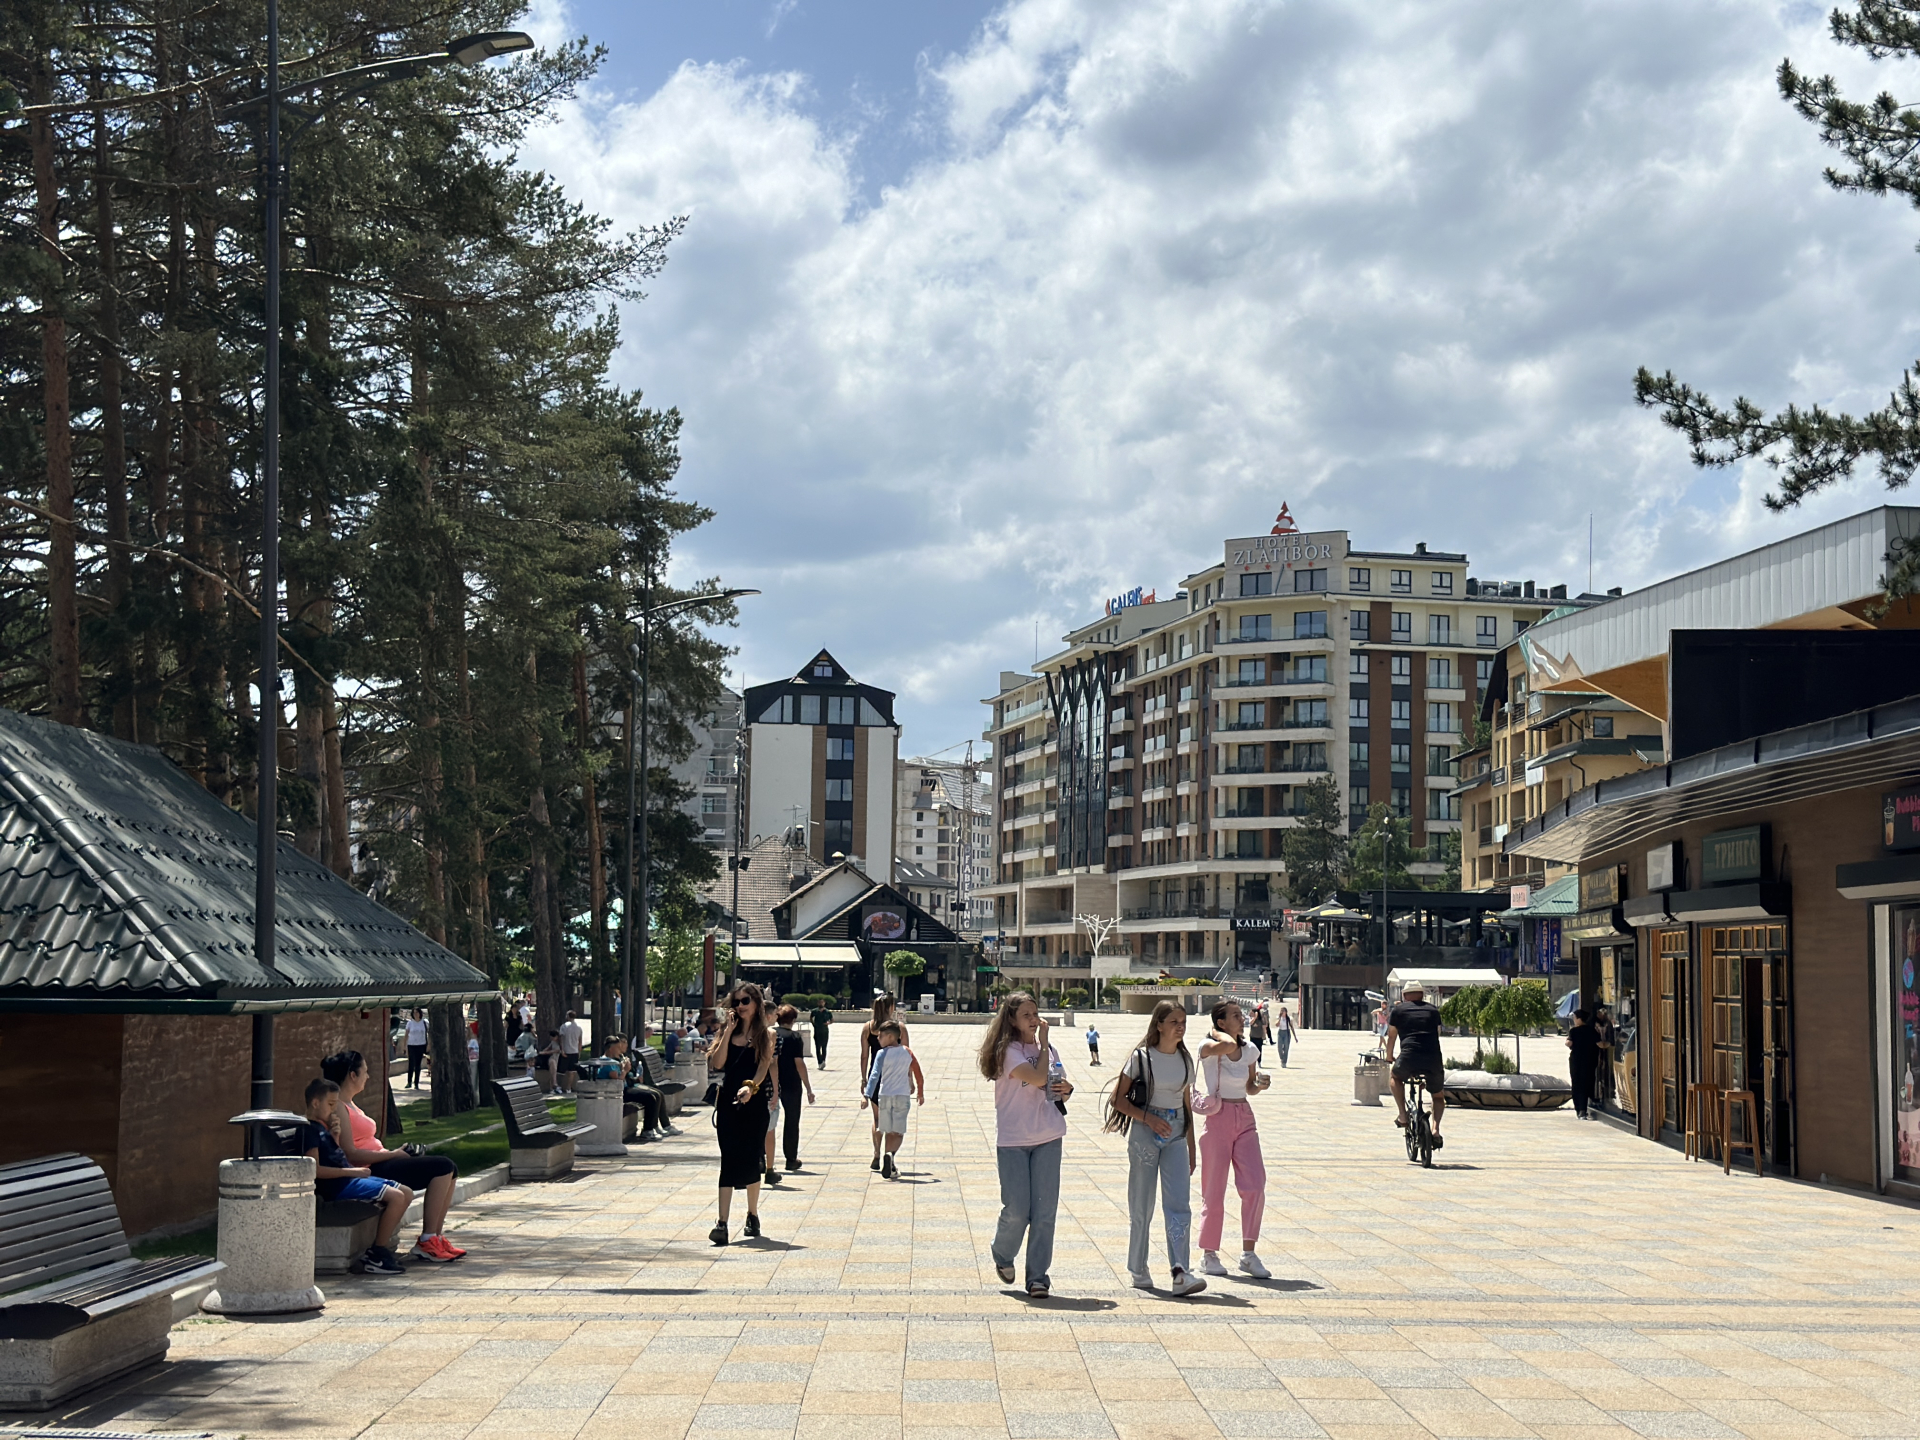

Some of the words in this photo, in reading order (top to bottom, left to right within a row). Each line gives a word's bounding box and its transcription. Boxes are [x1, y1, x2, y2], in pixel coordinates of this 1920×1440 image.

[1255, 535, 1311, 549] HOTEL
[1234, 544, 1332, 565] ZLATIBOR
[963, 855, 971, 929] FABERING
[1236, 919, 1271, 927] KALEM
